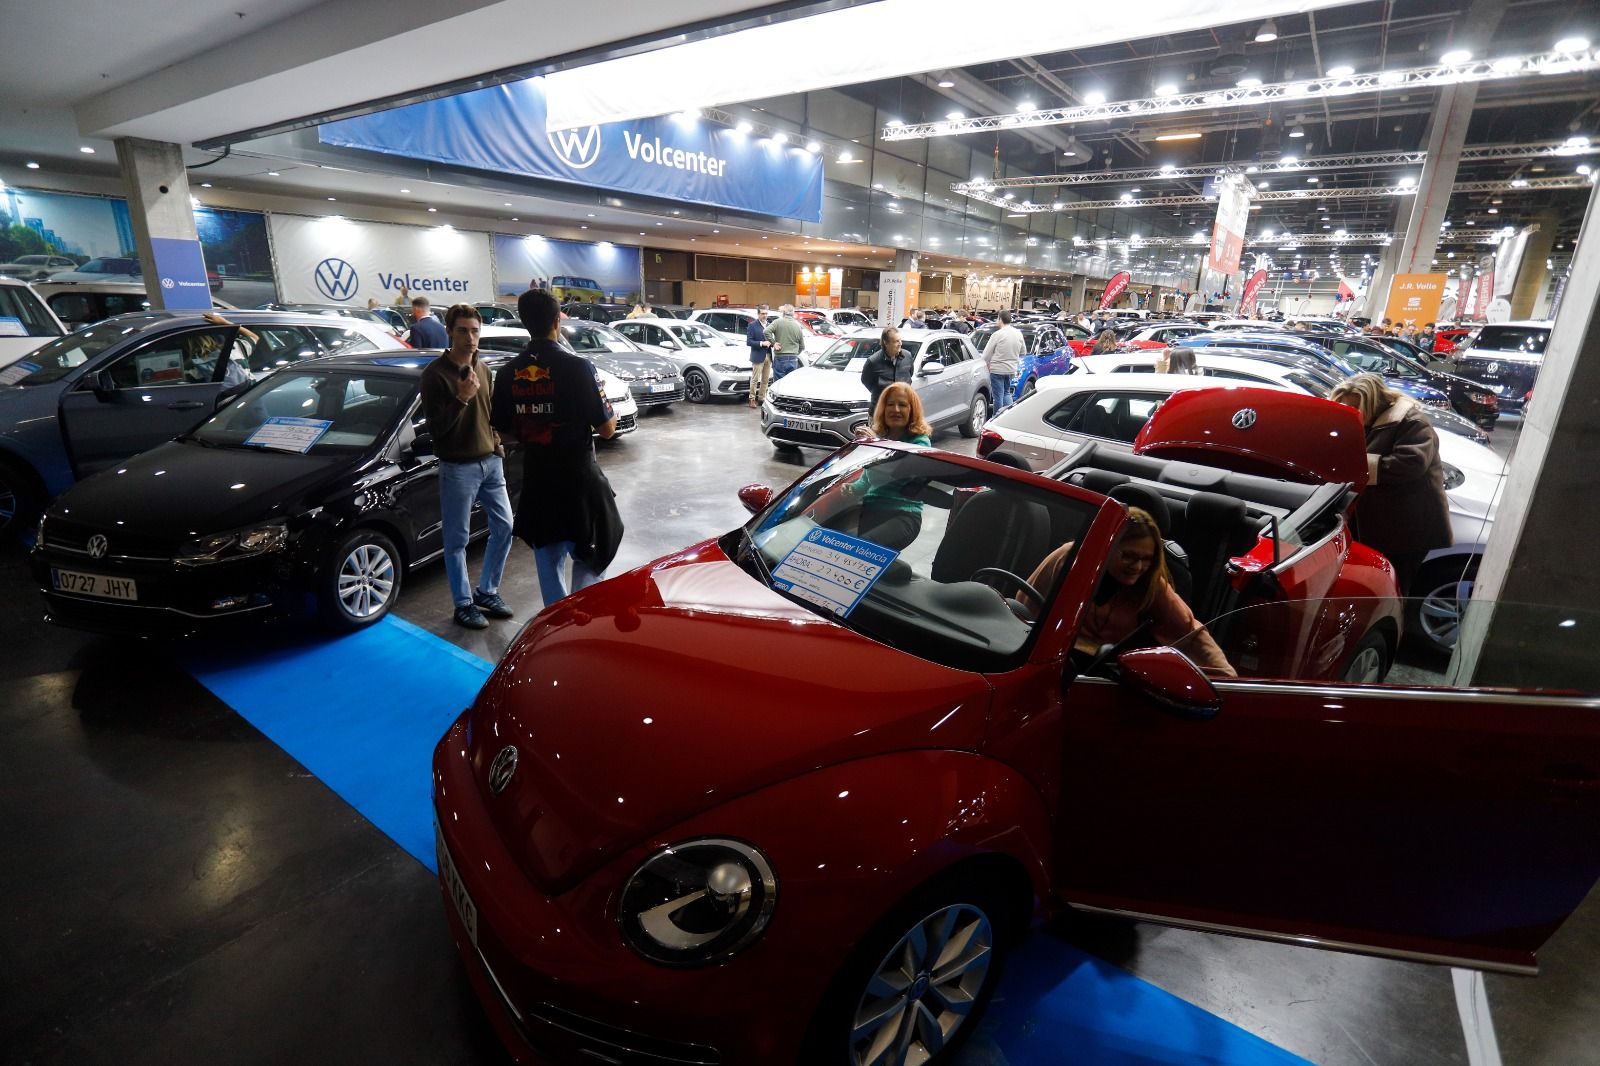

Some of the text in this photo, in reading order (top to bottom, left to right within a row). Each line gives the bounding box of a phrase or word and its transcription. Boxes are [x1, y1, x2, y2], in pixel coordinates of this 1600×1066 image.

[623, 130, 727, 177] Volcenter
[378, 273, 469, 292] Volcenter
[1099, 278, 1128, 311] NISSAN
[511, 381, 556, 396] Red Bull
[515, 404, 543, 414] Mobil
[787, 420, 804, 429] 9770
[821, 535, 855, 551] Volcenter
[855, 545, 888, 564] Valencia
[60, 572, 131, 597] 0727 JHY
